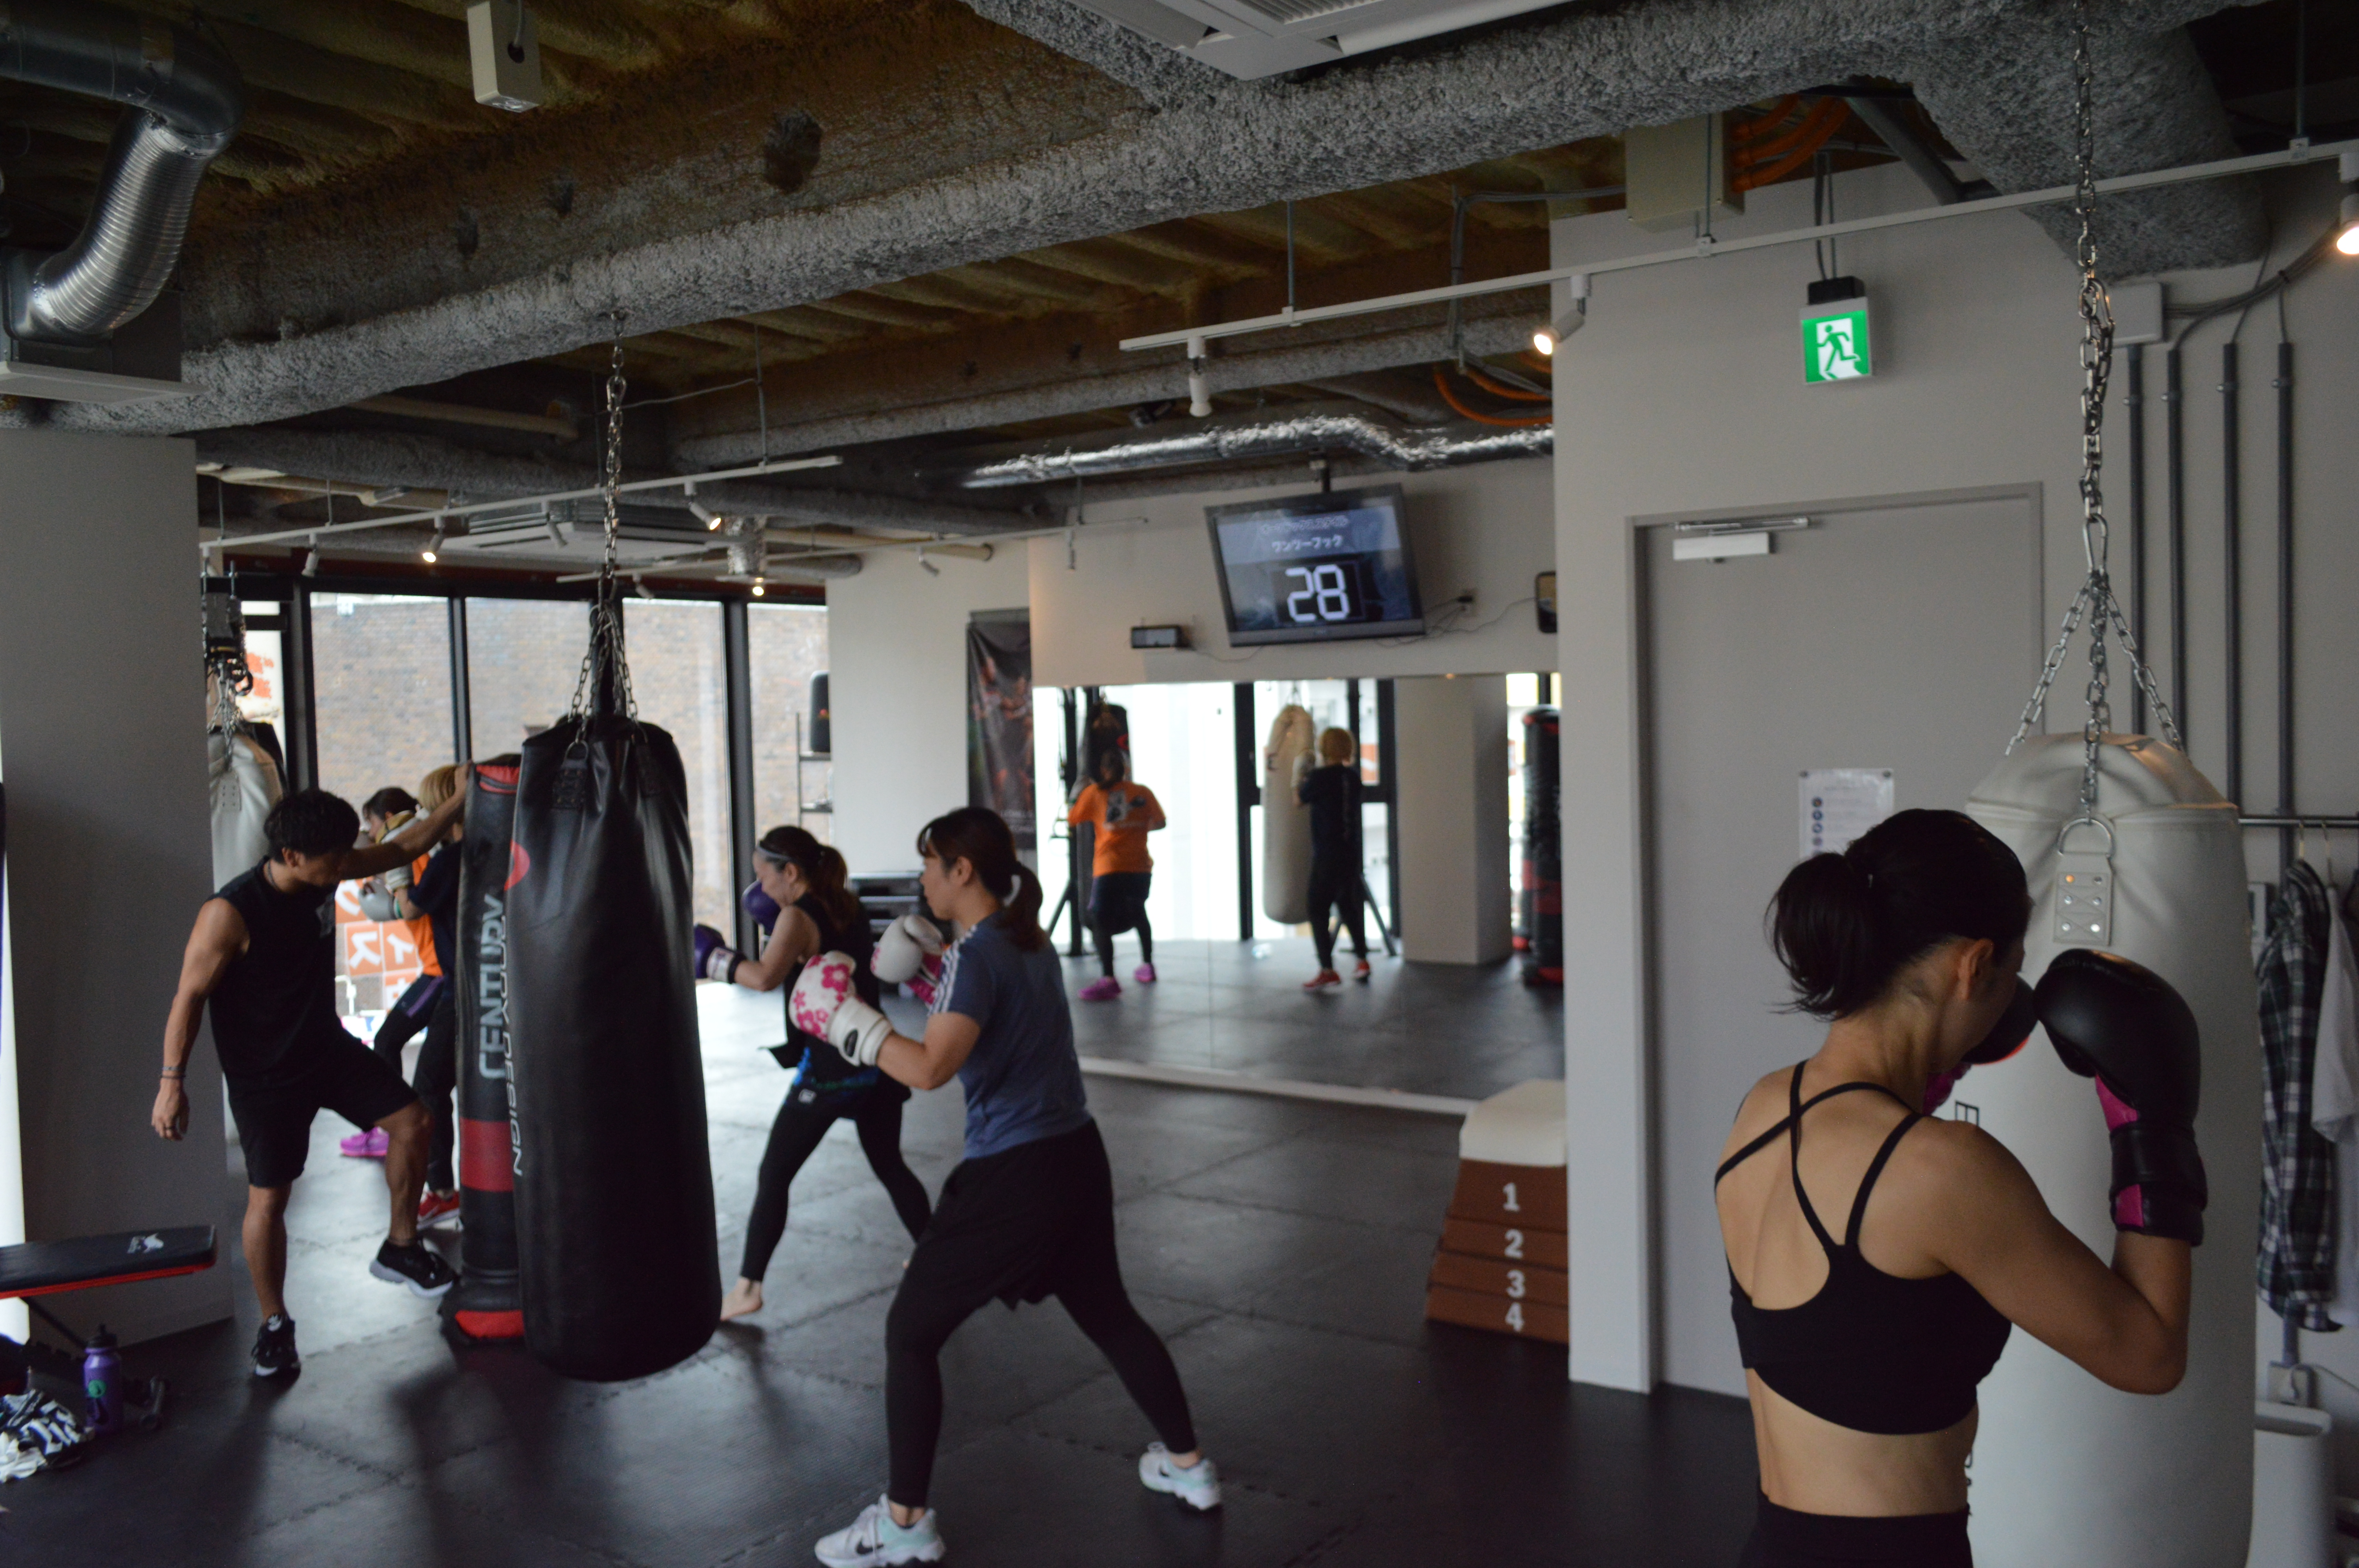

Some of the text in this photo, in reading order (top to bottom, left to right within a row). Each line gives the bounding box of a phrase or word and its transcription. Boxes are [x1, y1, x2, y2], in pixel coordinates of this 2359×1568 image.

[1285, 564, 1350, 622] 28
[502, 1031, 523, 1177] DESIGN
[1502, 1182, 1521, 1212] 1
[1505, 1229, 1524, 1259] 2
[1506, 1269, 1526, 1299] 3
[1505, 1301, 1525, 1332] 4
